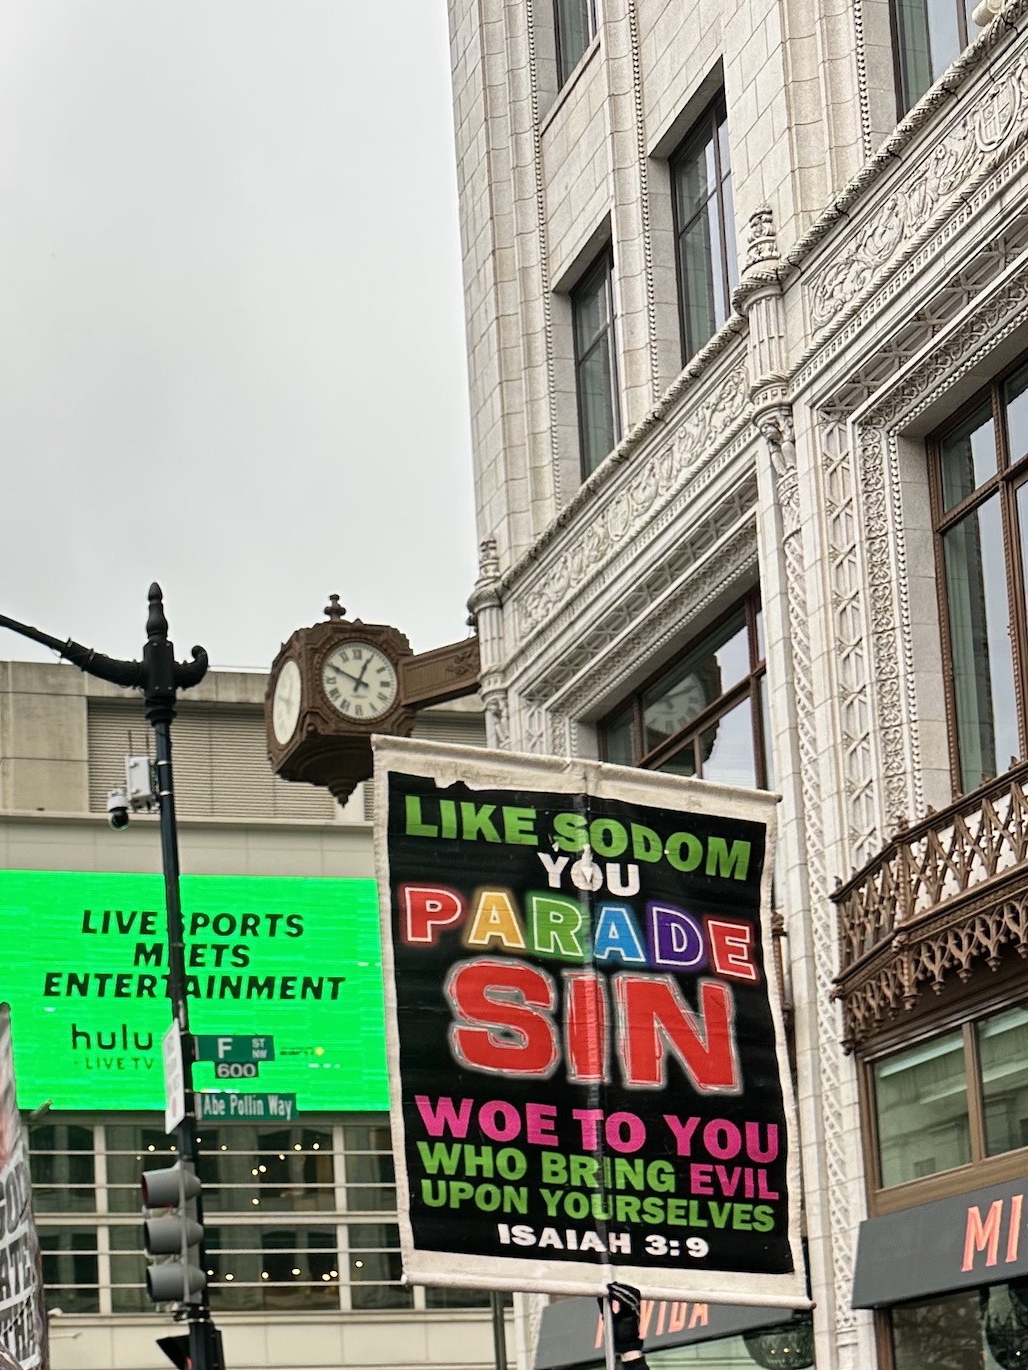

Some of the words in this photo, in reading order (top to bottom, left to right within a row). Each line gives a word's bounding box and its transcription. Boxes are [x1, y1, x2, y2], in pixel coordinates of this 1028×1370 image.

[405, 795, 538, 845] LIKE
[553, 812, 751, 881] SODOM
[537, 852, 641, 896] YOU
[82, 910, 158, 934] LIVE
[404, 886, 756, 980] PARADE
[133, 943, 251, 967] METS
[72, 1023, 153, 1050] hulu
[252, 1038, 265, 1048] ST
[447, 958, 740, 1093] SIN
[85, 1058, 129, 1069] LIVE
[133, 1058, 154, 1069] TV
[217, 1038, 233, 1058] F
[252, 1050, 267, 1059] NW
[217, 1063, 256, 1078] 600
[204, 1094, 226, 1116] Abe
[230, 1095, 264, 1116] Pollin
[268, 1095, 292, 1121] Way
[414, 1095, 559, 1146] WOE
[572, 1109, 646, 1153] TO
[663, 1114, 778, 1163] YOU
[416, 1141, 527, 1180] WHO
[541, 1151, 676, 1192] BRING
[690, 1163, 780, 1199] EVIL
[421, 1179, 528, 1214] UPON
[540, 1189, 775, 1232] YOURSELVES
[497, 1223, 632, 1254] ISAIAH
[645, 1235, 709, 1258] 3:9
[961, 1194, 1024, 1272] MI
[639, 1300, 709, 1340] VIDA
